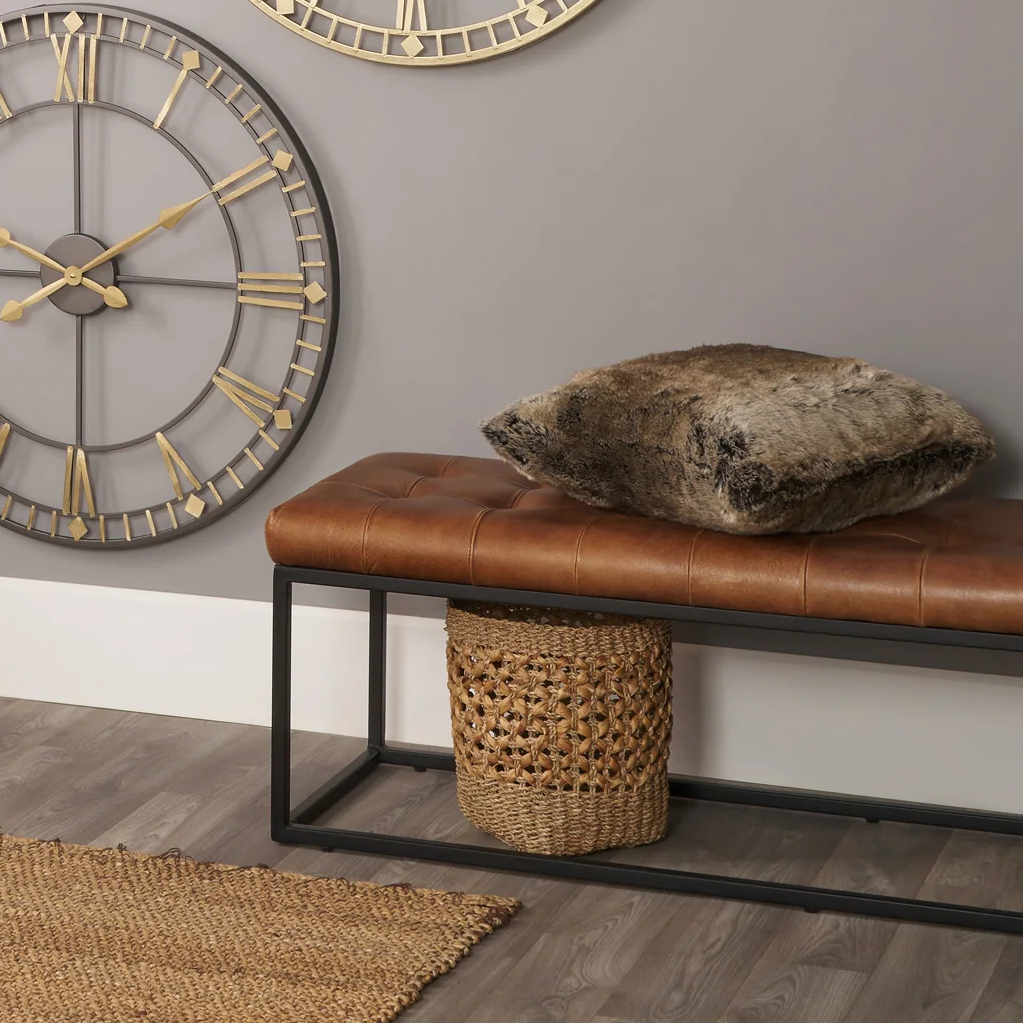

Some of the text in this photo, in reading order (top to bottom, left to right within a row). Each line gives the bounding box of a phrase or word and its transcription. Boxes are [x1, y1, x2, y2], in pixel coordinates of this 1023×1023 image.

[50, 33, 97, 104] XII
[153, 68, 188, 129] I
[237, 272, 303, 310] III
[63, 445, 96, 517] VI
[155, 431, 202, 501] V
